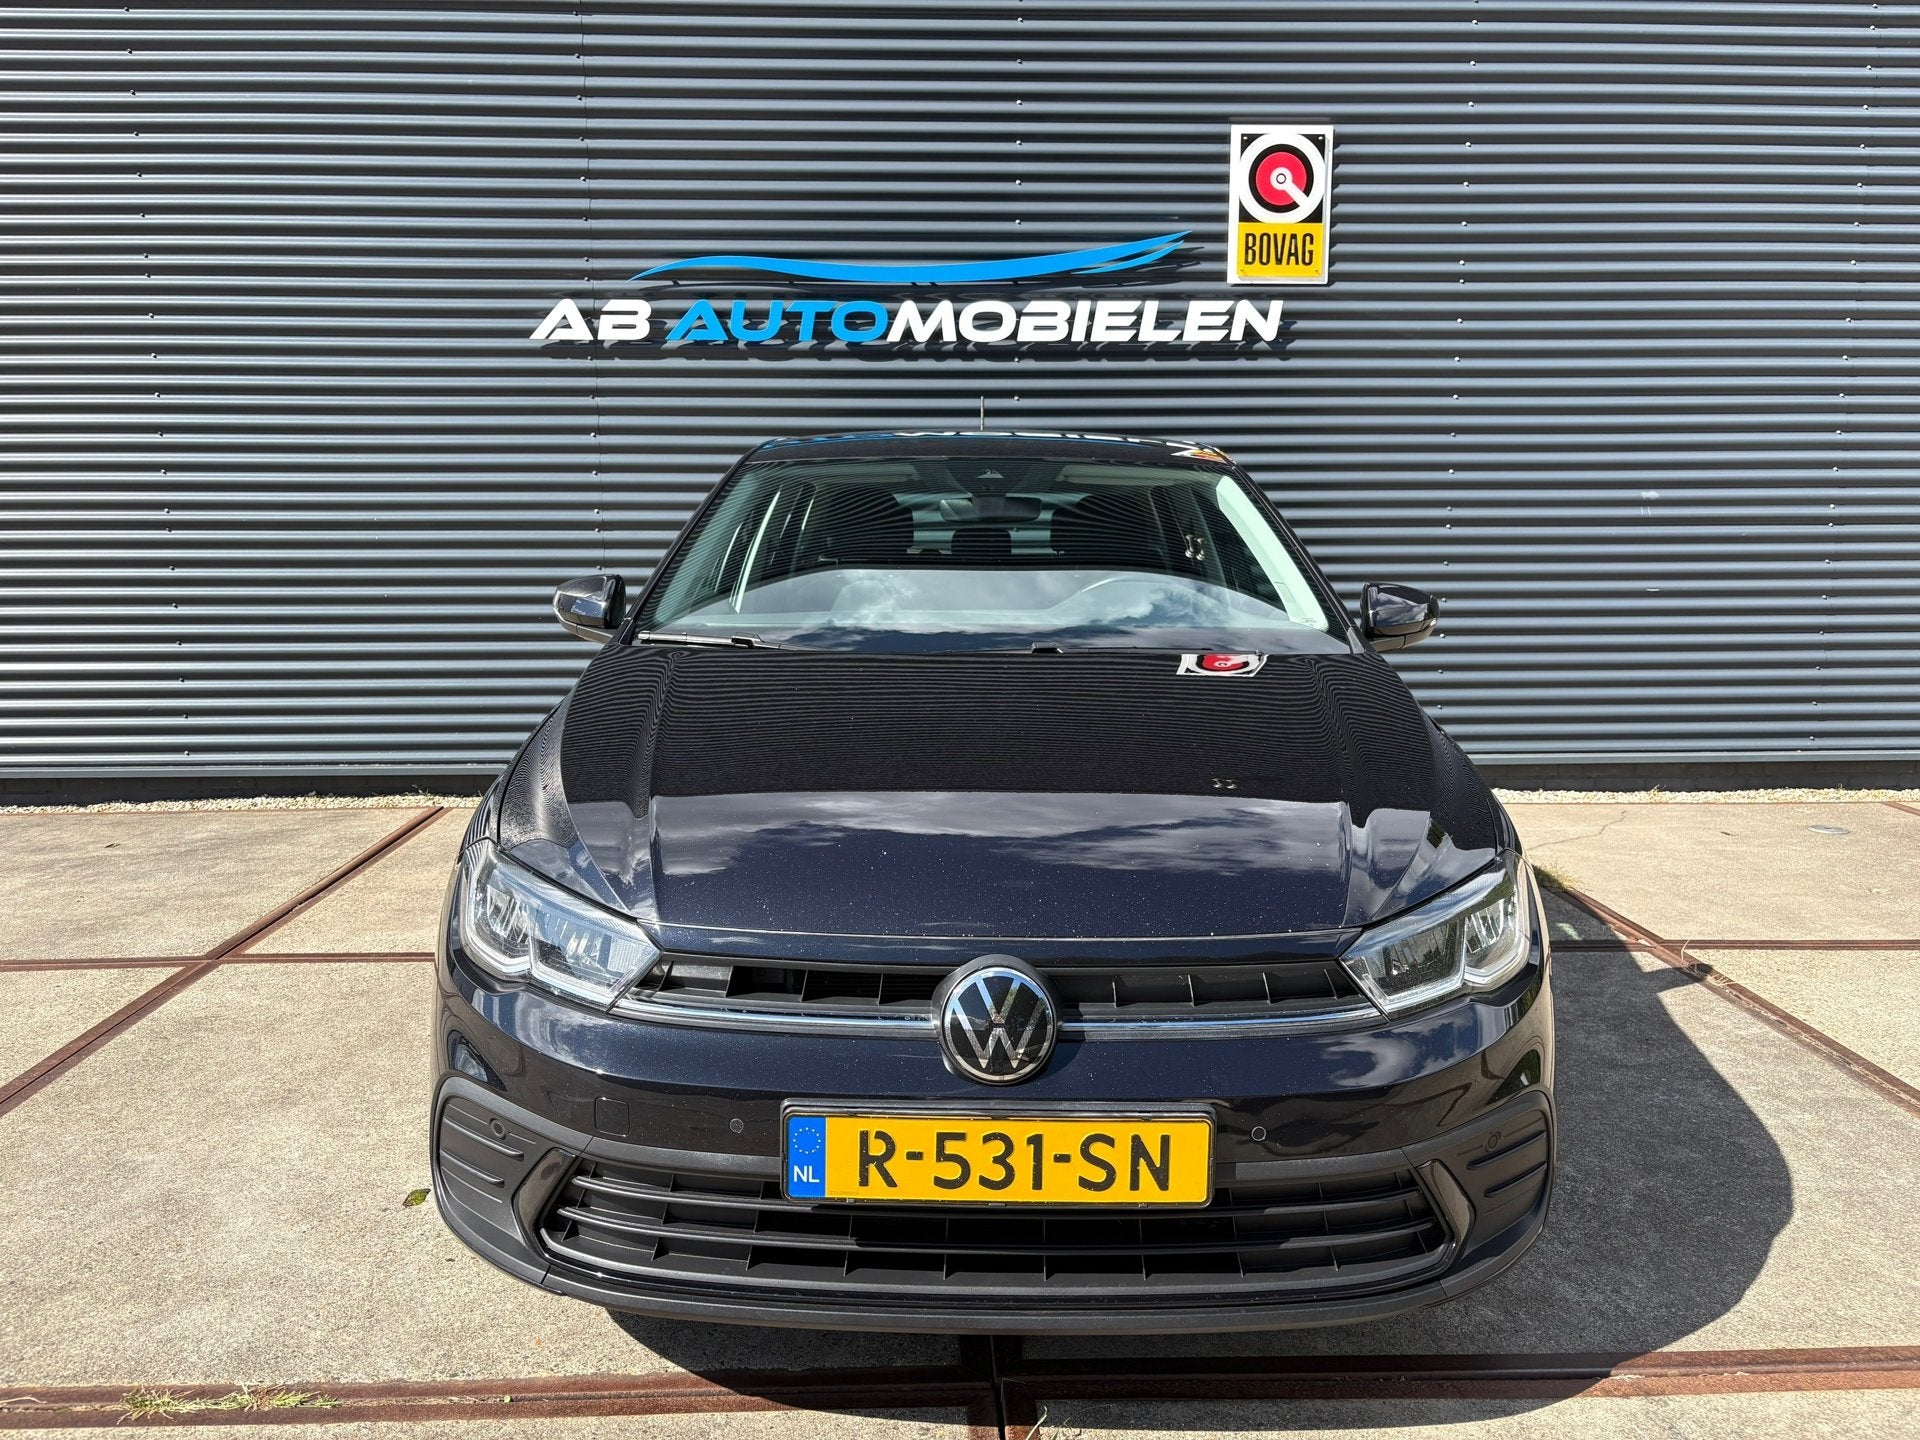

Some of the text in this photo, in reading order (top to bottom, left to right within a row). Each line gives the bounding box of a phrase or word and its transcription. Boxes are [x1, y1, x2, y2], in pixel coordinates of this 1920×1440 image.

[1244, 232, 1314, 267] BOVAG
[530, 298, 1284, 343] AB AUTOMOBIELEN
[793, 1165, 820, 1183] NL
[858, 1129, 1170, 1192] R-531-SN
